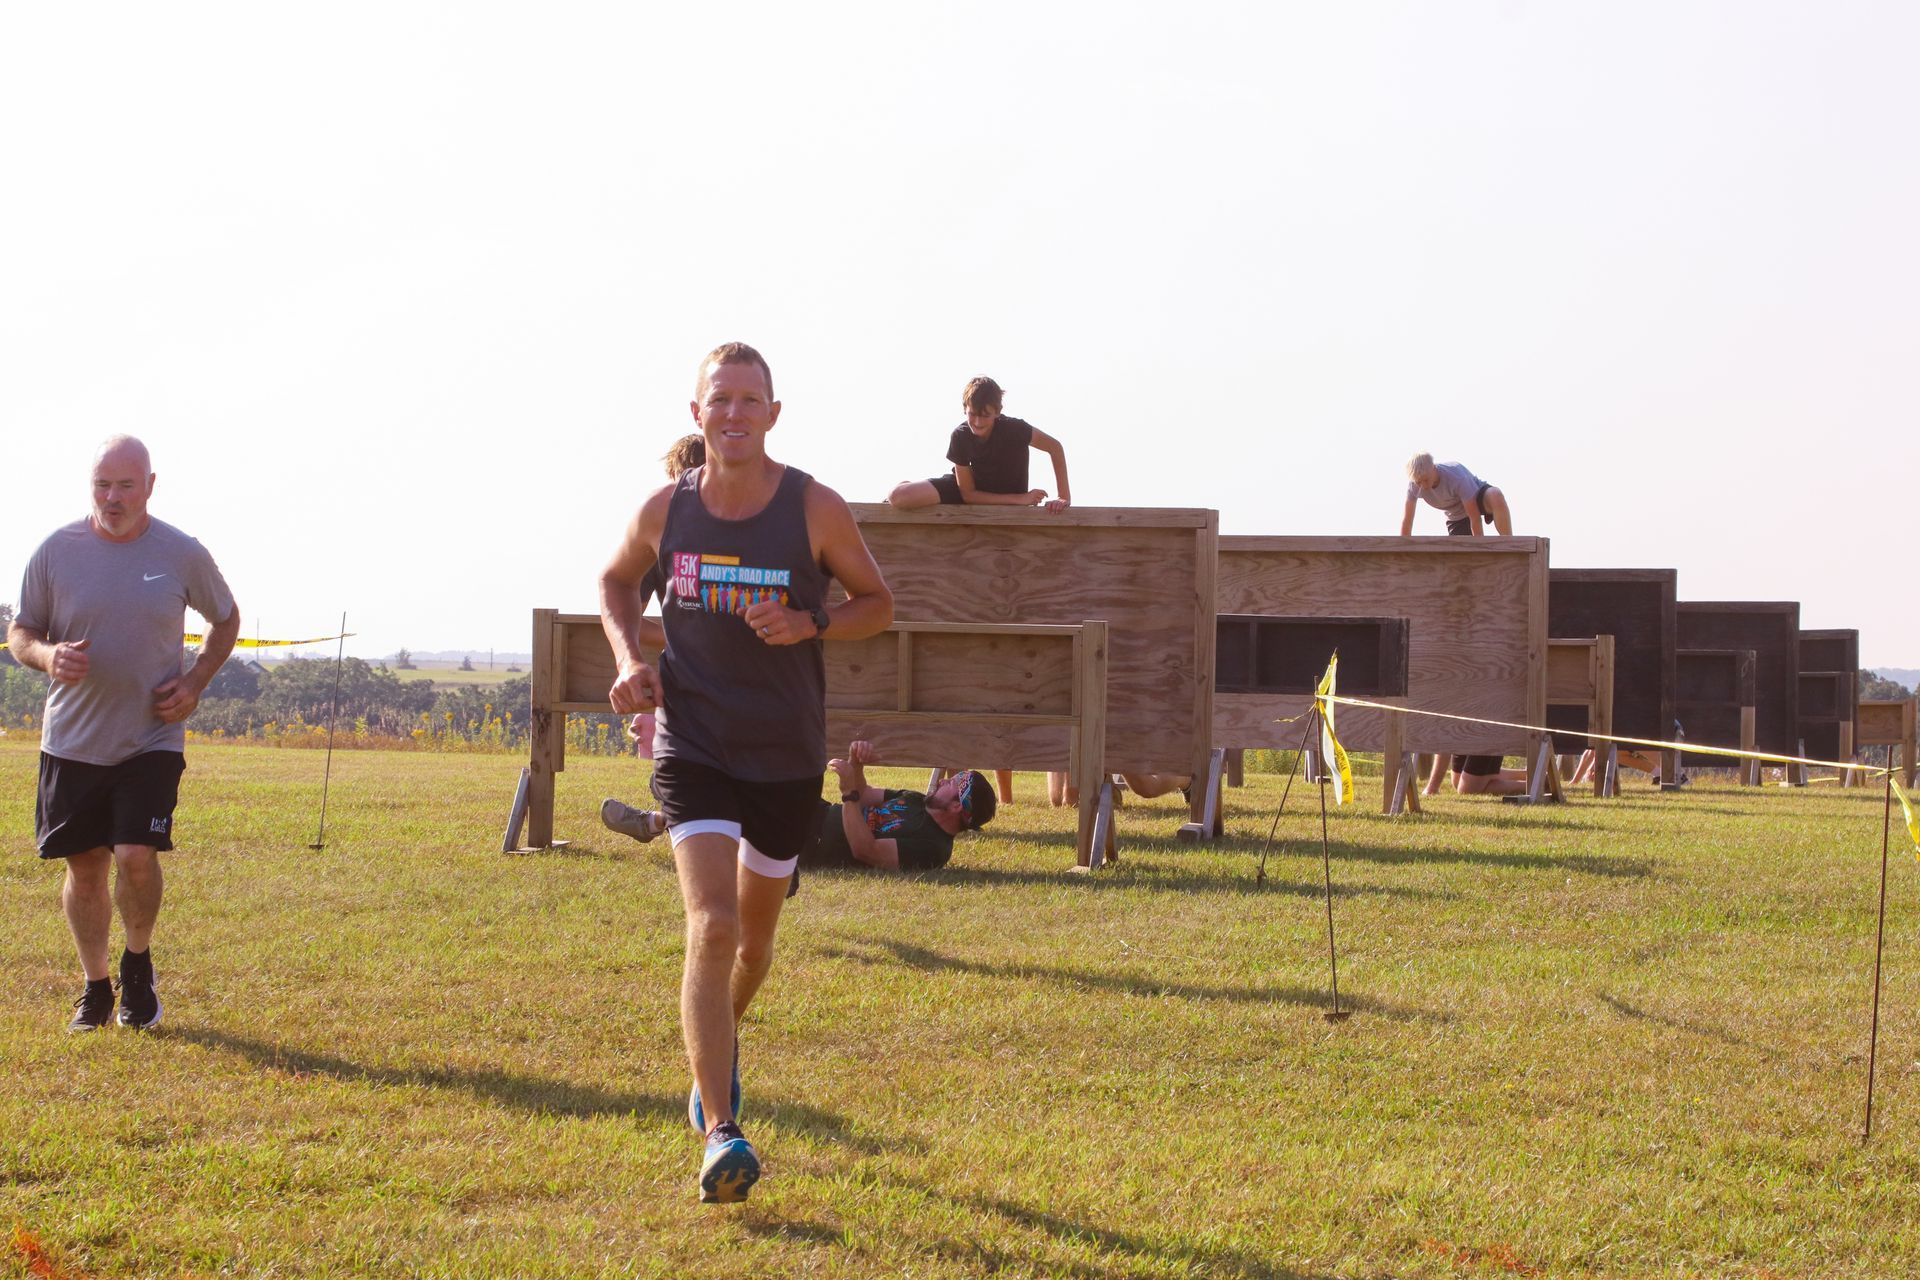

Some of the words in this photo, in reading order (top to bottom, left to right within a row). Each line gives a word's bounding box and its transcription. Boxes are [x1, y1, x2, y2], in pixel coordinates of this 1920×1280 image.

[681, 555, 698, 575] 5K
[701, 565, 736, 581] ANDY'S
[738, 568, 762, 583] ROAD
[764, 570, 789, 586] RACE
[674, 577, 697, 597] 10K
